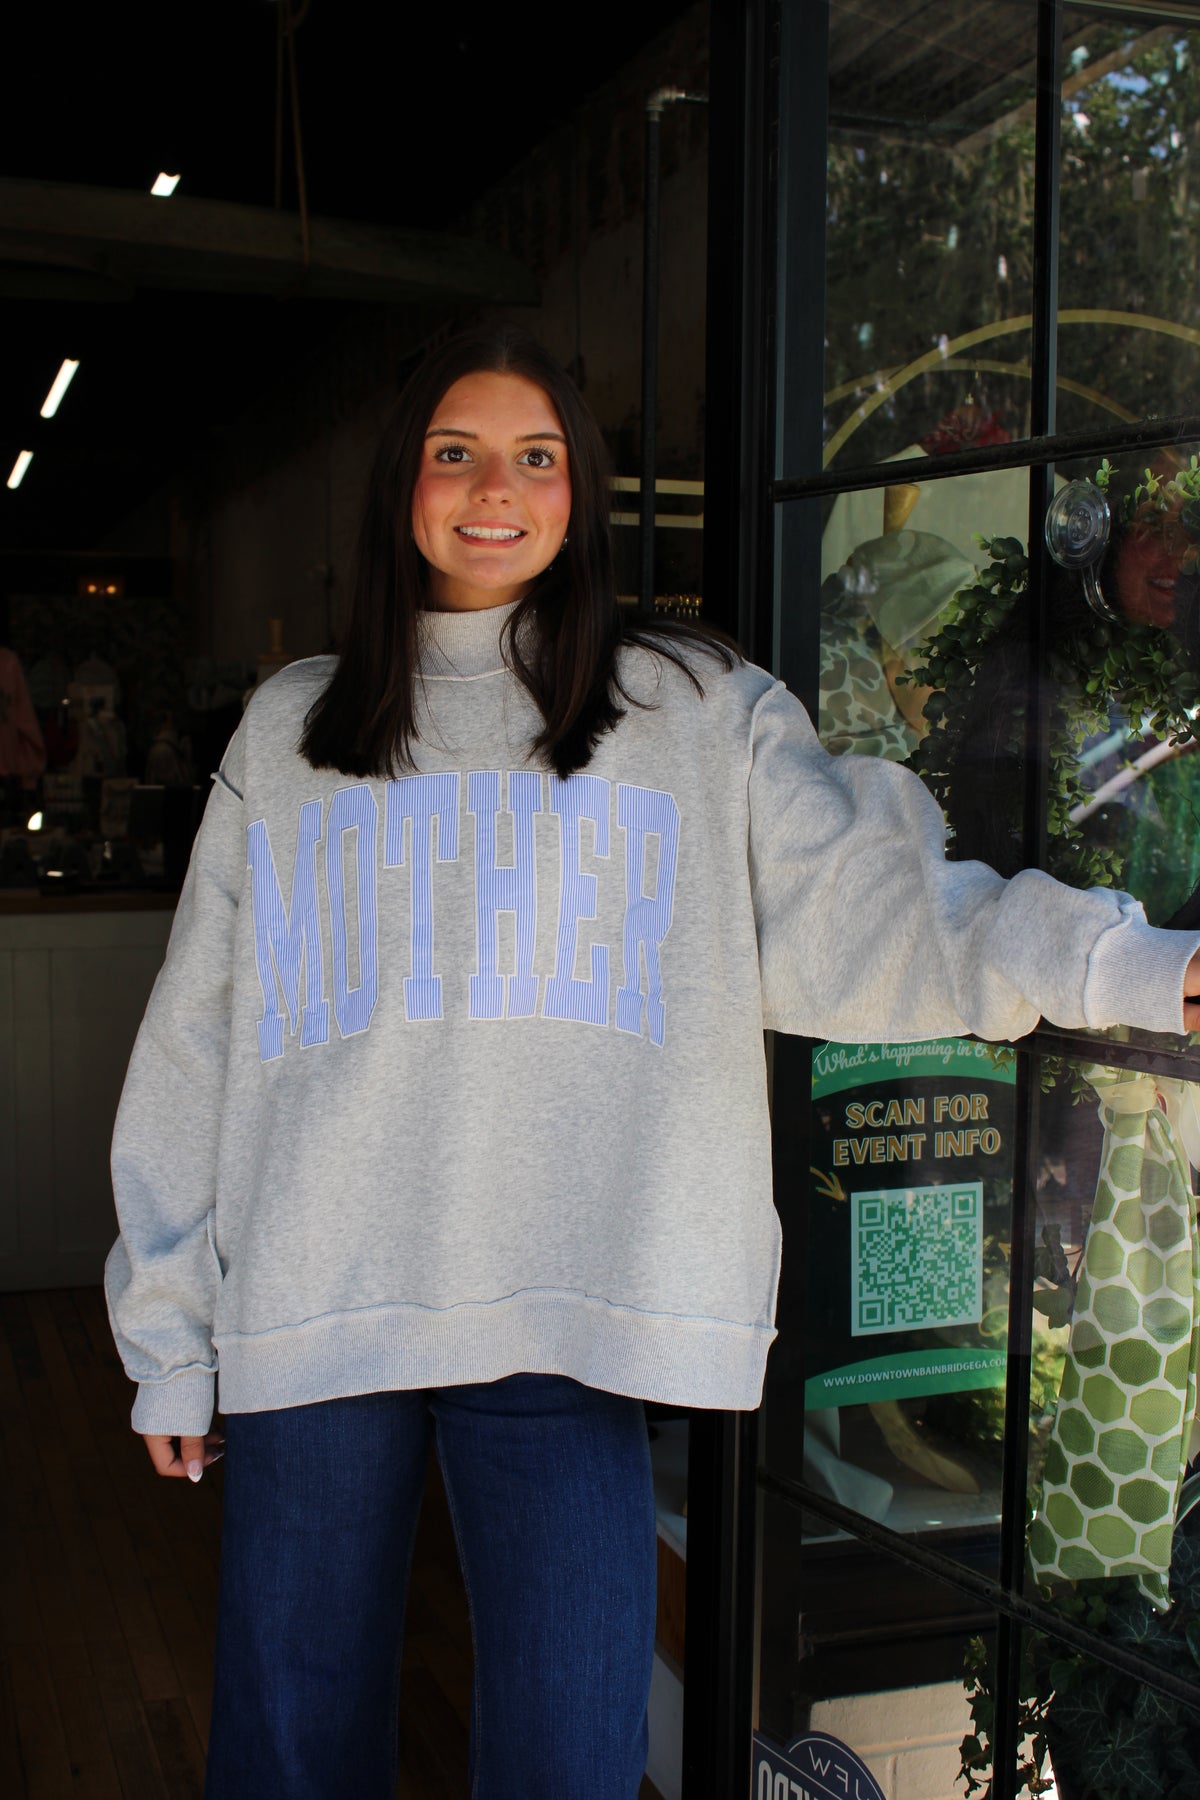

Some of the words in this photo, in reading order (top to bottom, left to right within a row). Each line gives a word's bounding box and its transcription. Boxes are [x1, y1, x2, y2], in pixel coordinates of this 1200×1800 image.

[246, 769, 681, 1064] MOTHER
[817, 1044, 879, 1075] What's
[881, 1041, 955, 1067] happening
[956, 1041, 972, 1056] in
[846, 1098, 925, 1129] SCAN
[934, 1094, 989, 1123] FOR
[833, 1133, 927, 1166] EVENT
[935, 1128, 1001, 1158] INFO
